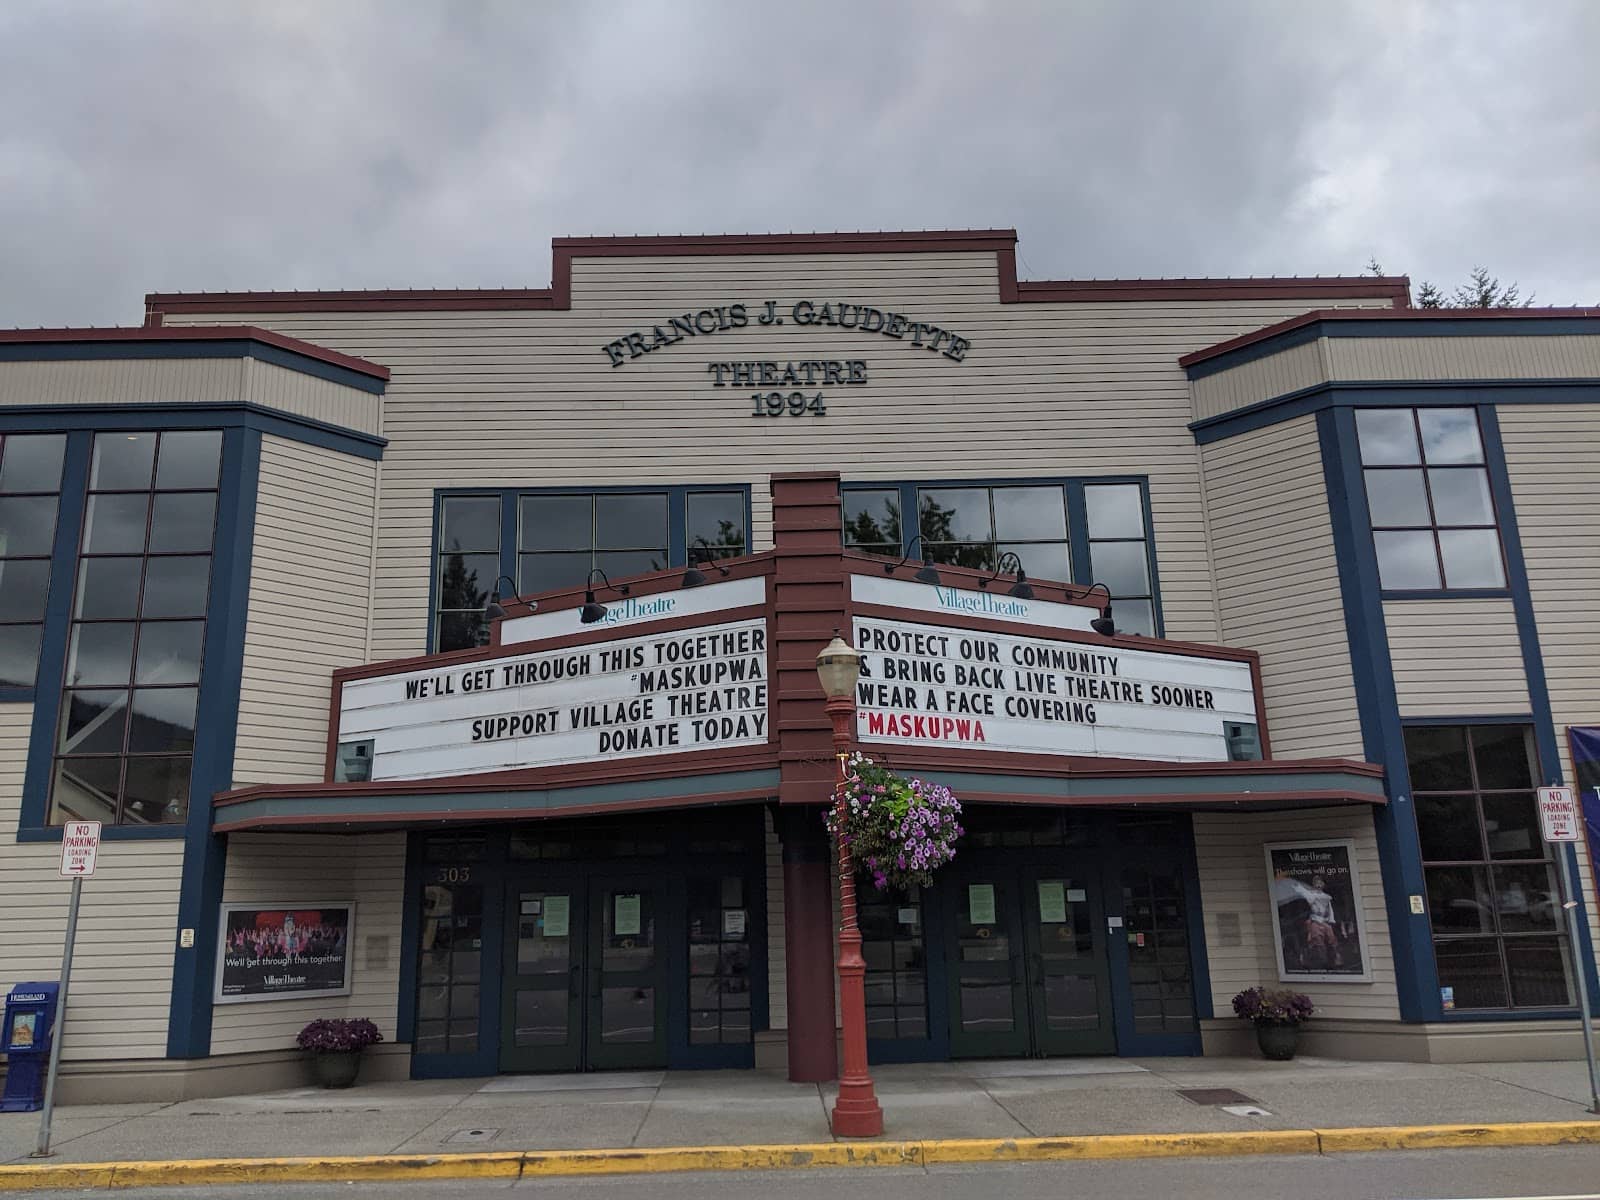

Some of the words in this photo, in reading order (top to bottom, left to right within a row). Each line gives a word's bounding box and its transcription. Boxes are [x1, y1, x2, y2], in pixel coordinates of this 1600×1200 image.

[602, 303, 748, 368] FRANCIS
[758, 300, 784, 326] J.
[792, 300, 972, 363] GAUDETTE
[708, 360, 867, 387] THEATRE
[751, 391, 827, 417] 1994
[406, 675, 455, 700] WE'LL
[462, 670, 494, 692] GET
[504, 655, 590, 686] THROUGH
[600, 647, 644, 671] THIS
[655, 629, 765, 663] TOGETHER
[859, 627, 948, 657] PROTECT
[960, 639, 999, 663] OUR
[1012, 645, 1118, 676] COMMUNITY
[859, 655, 871, 677] &
[884, 657, 946, 684] BRING
[955, 665, 1006, 690] BACK
[1016, 671, 1057, 695] LIVE
[1064, 676, 1143, 703] THEATRE
[1151, 685, 1215, 710] SOONER
[472, 711, 559, 741] SUPPORT
[570, 699, 654, 729] VILLAGE
[668, 685, 767, 717] THEATRE
[858, 683, 917, 709] WEAR
[926, 689, 938, 711] A
[946, 690, 994, 715] FACE
[1005, 696, 1097, 724] COVERING
[600, 723, 679, 753] DONATE
[692, 713, 767, 742] TODAY
[1542, 802, 1573, 813] PARKING
[1549, 791, 1562, 801] NO
[65, 836, 97, 848] PARKING
[75, 825, 90, 836] NO
[1326, 867, 1337, 876] go
[247, 958, 260, 969] get
[262, 956, 292, 967] through
[294, 955, 308, 965] this
